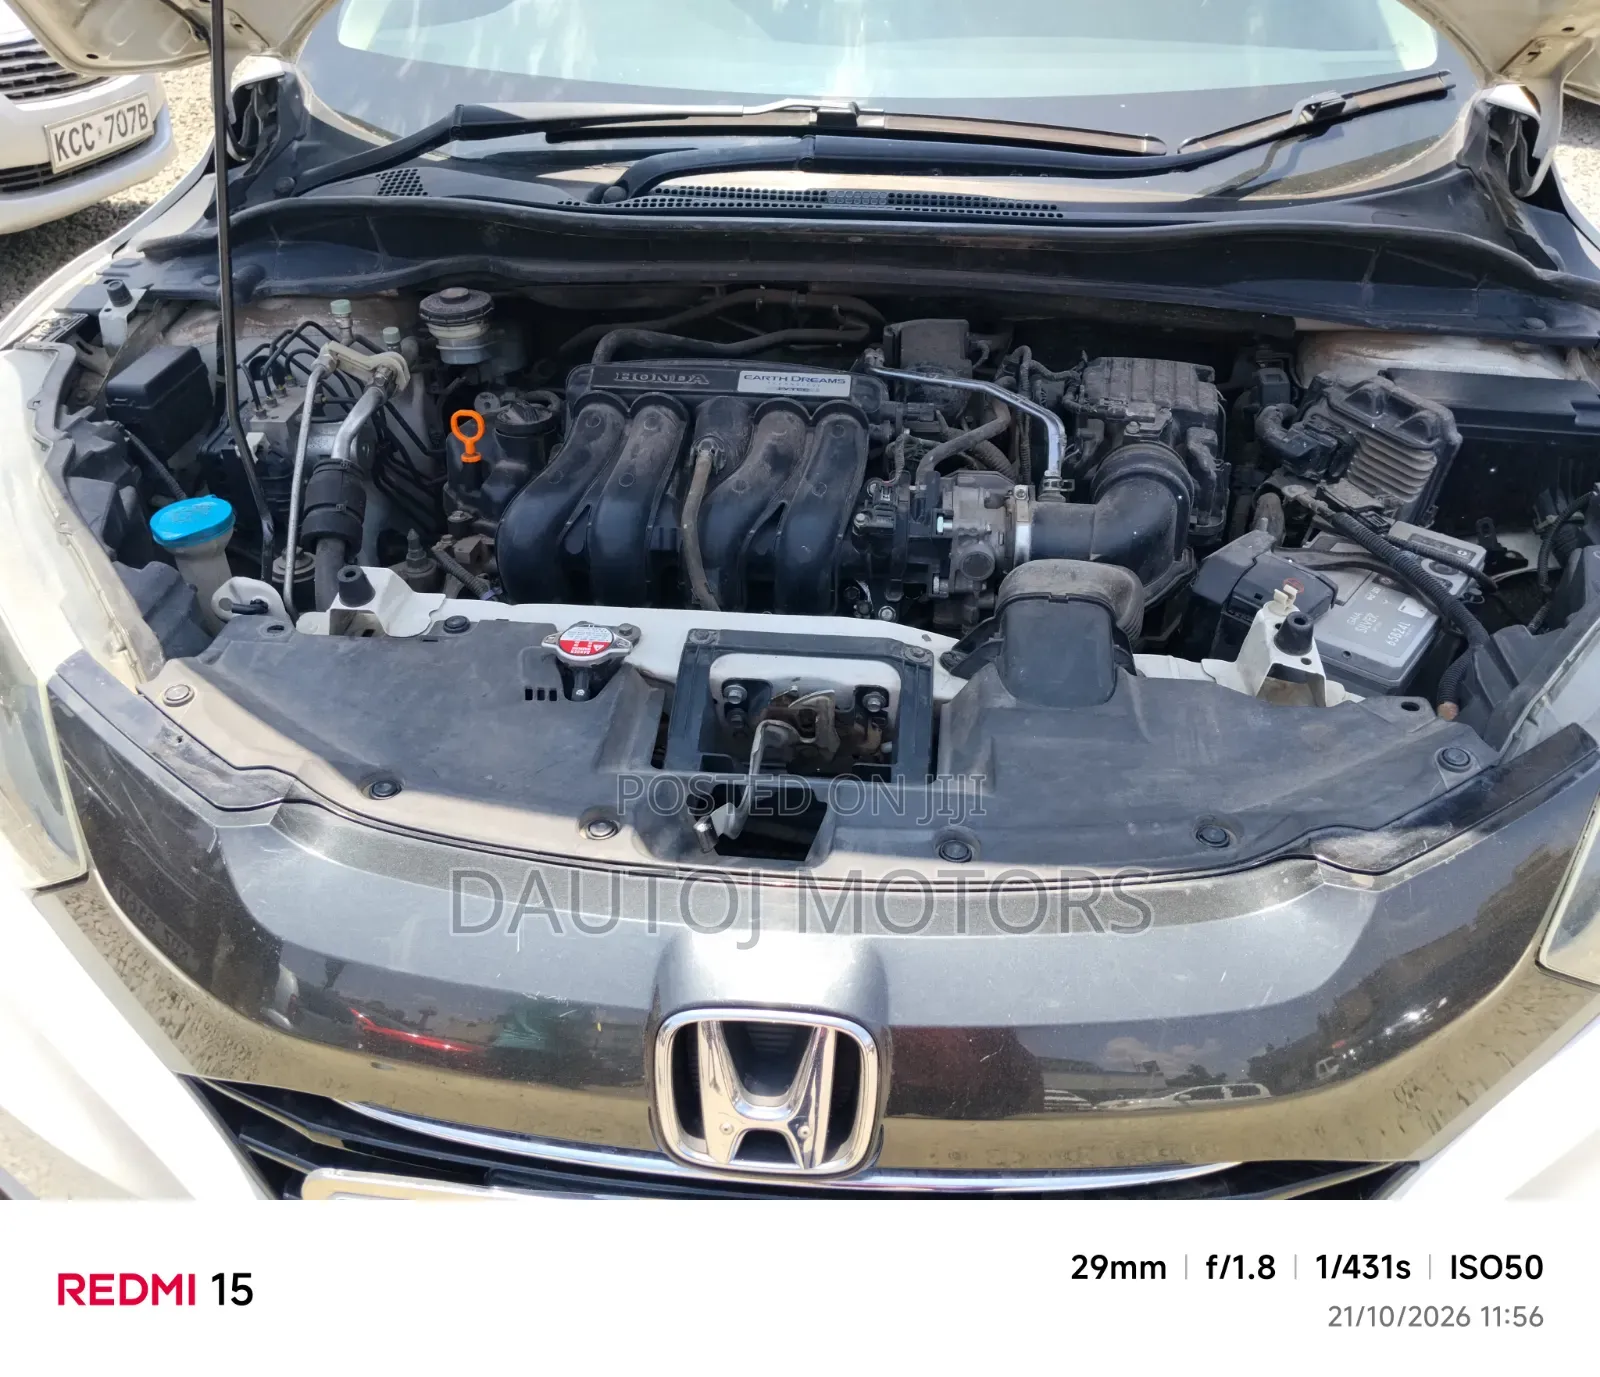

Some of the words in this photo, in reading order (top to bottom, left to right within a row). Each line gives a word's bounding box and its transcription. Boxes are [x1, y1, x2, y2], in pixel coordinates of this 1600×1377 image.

[54, 122, 95, 162] KCC
[104, 103, 148, 144] 707B
[613, 371, 710, 385] HONDA
[743, 374, 788, 382] EARTH
[790, 375, 846, 385] DREAMS
